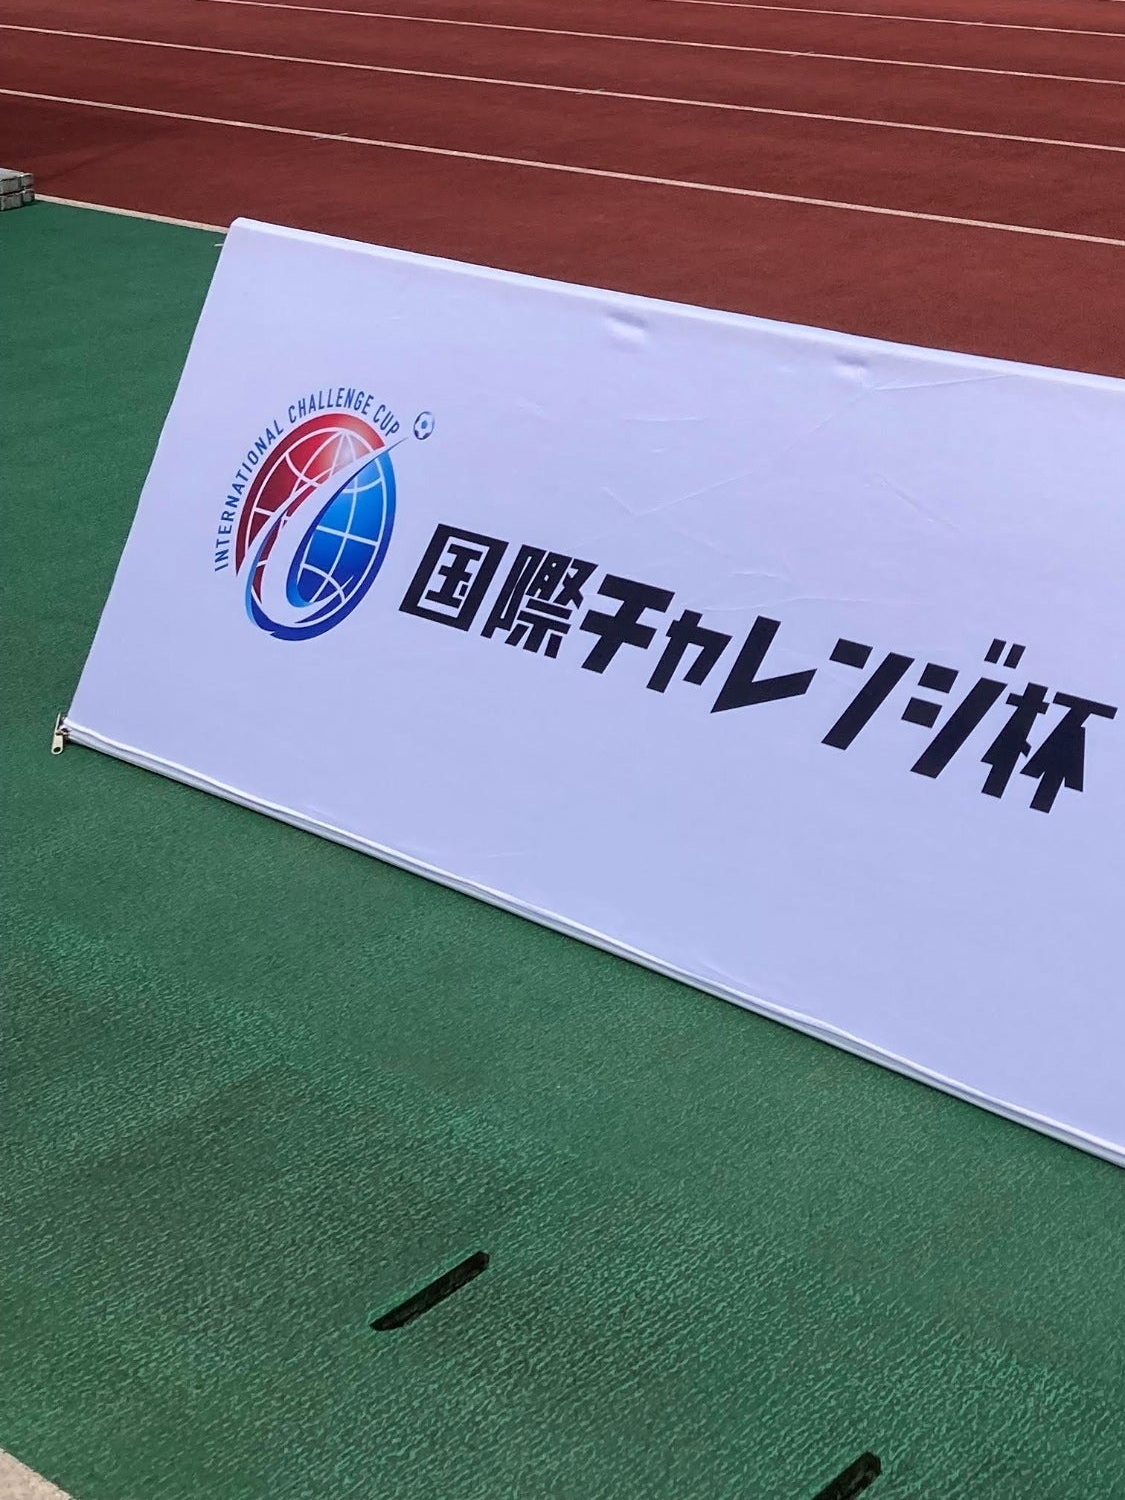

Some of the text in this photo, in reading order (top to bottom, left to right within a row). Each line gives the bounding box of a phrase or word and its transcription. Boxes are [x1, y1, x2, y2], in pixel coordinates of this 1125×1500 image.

[215, 387, 400, 572] INTERNATIONAL CHALLENGE CUP
[398, 523, 1118, 814] 国際チャレンジ杯
